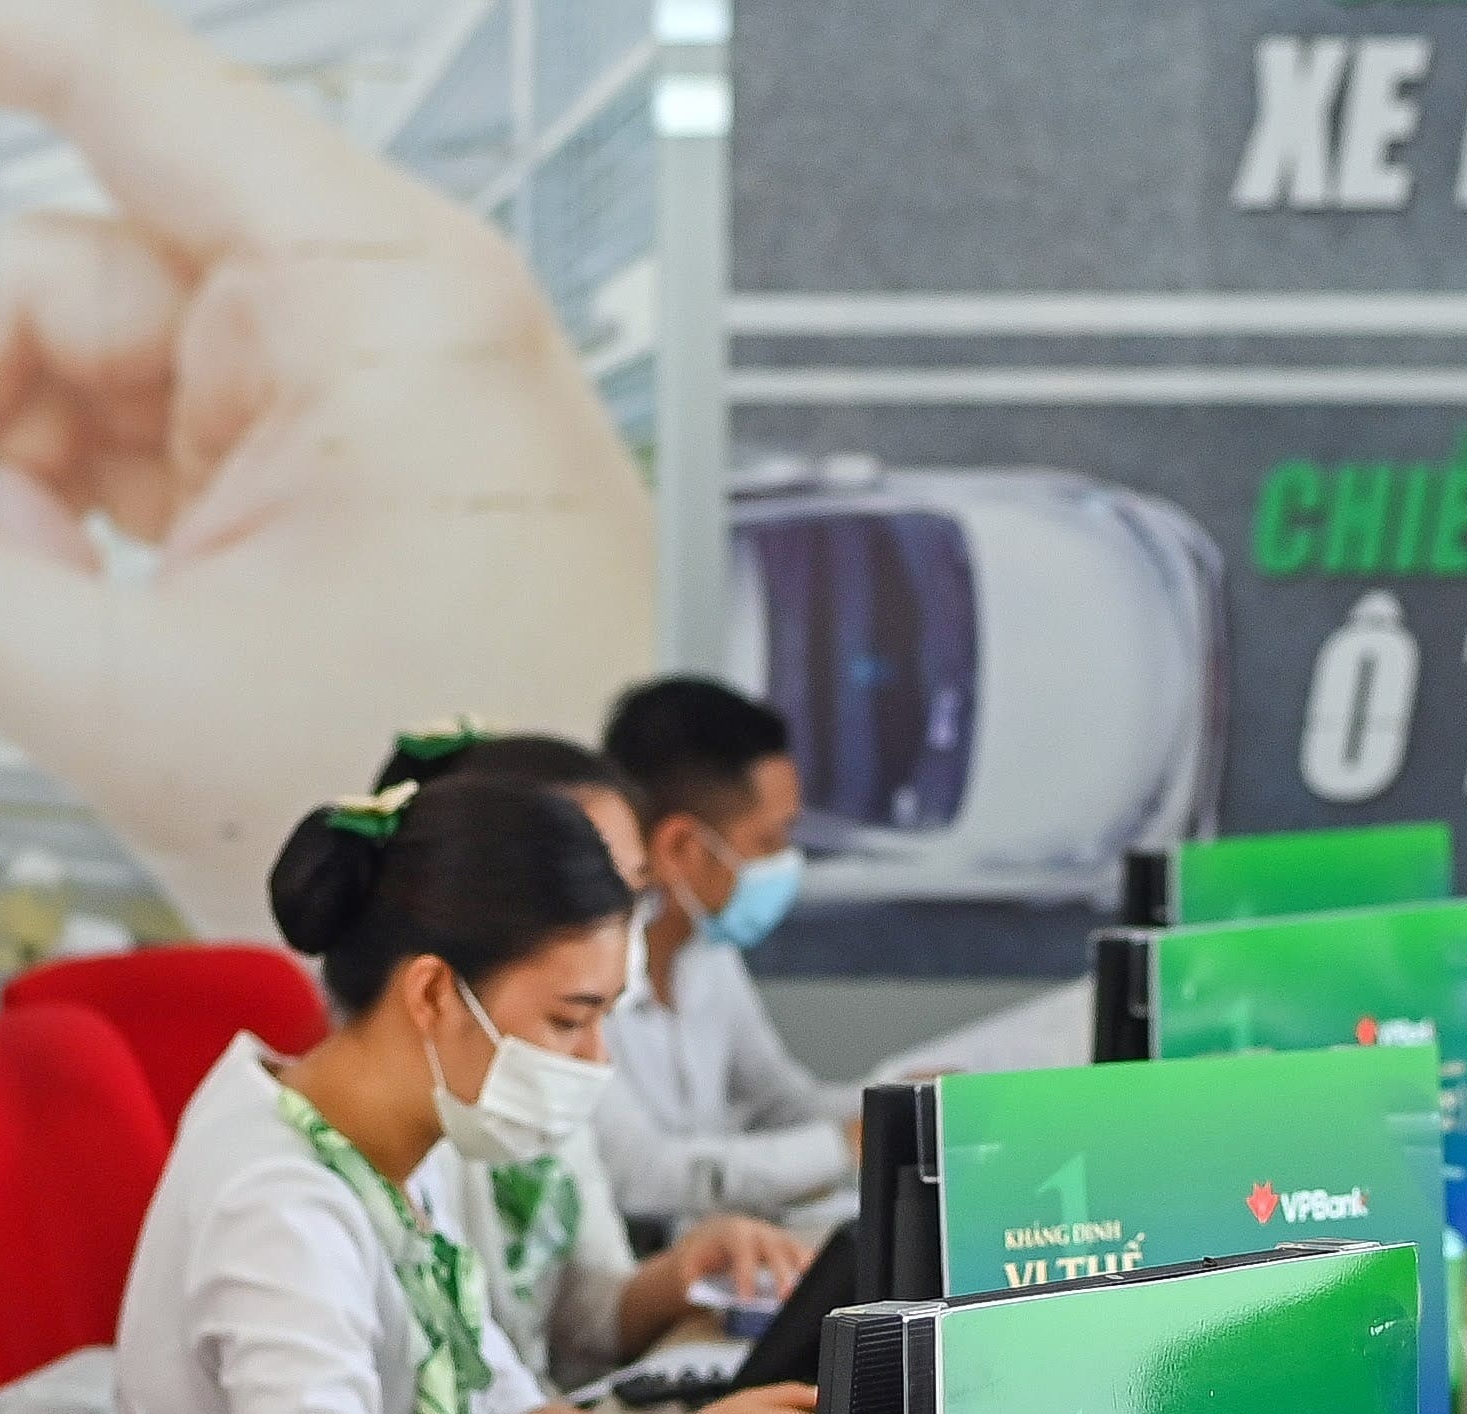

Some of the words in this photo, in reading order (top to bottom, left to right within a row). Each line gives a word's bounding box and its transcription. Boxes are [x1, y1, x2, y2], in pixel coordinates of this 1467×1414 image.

[1234, 36, 1432, 210] XE
[1300, 588, 1420, 801] Ô
[1280, 1187, 1371, 1224] VPBank
